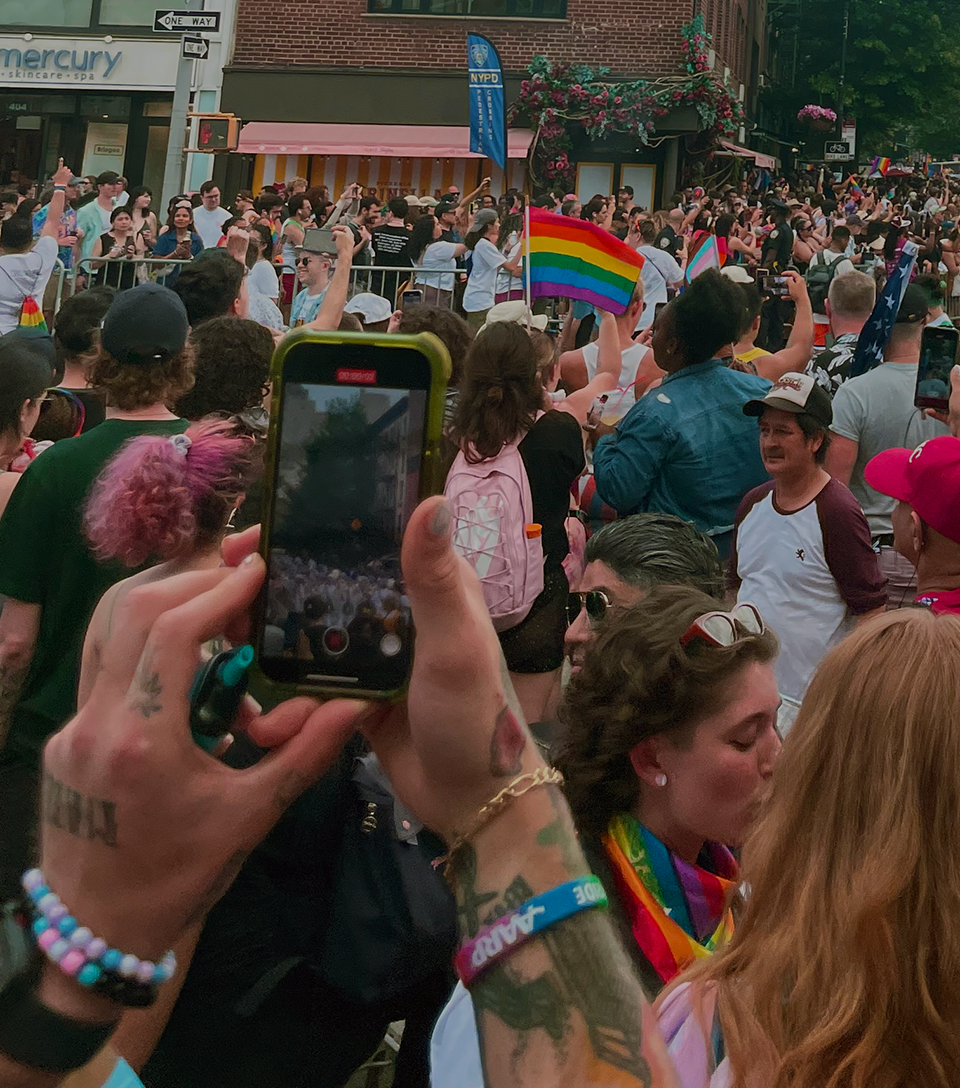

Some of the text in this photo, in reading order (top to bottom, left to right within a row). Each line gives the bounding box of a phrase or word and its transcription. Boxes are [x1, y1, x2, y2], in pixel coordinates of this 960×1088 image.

[164, 16, 212, 25] ONE WAY
[9, 69, 95, 81] skincare spa
[470, 73, 499, 83] NYPD
[9, 102, 27, 111] 404
[472, 905, 546, 968] AARP
